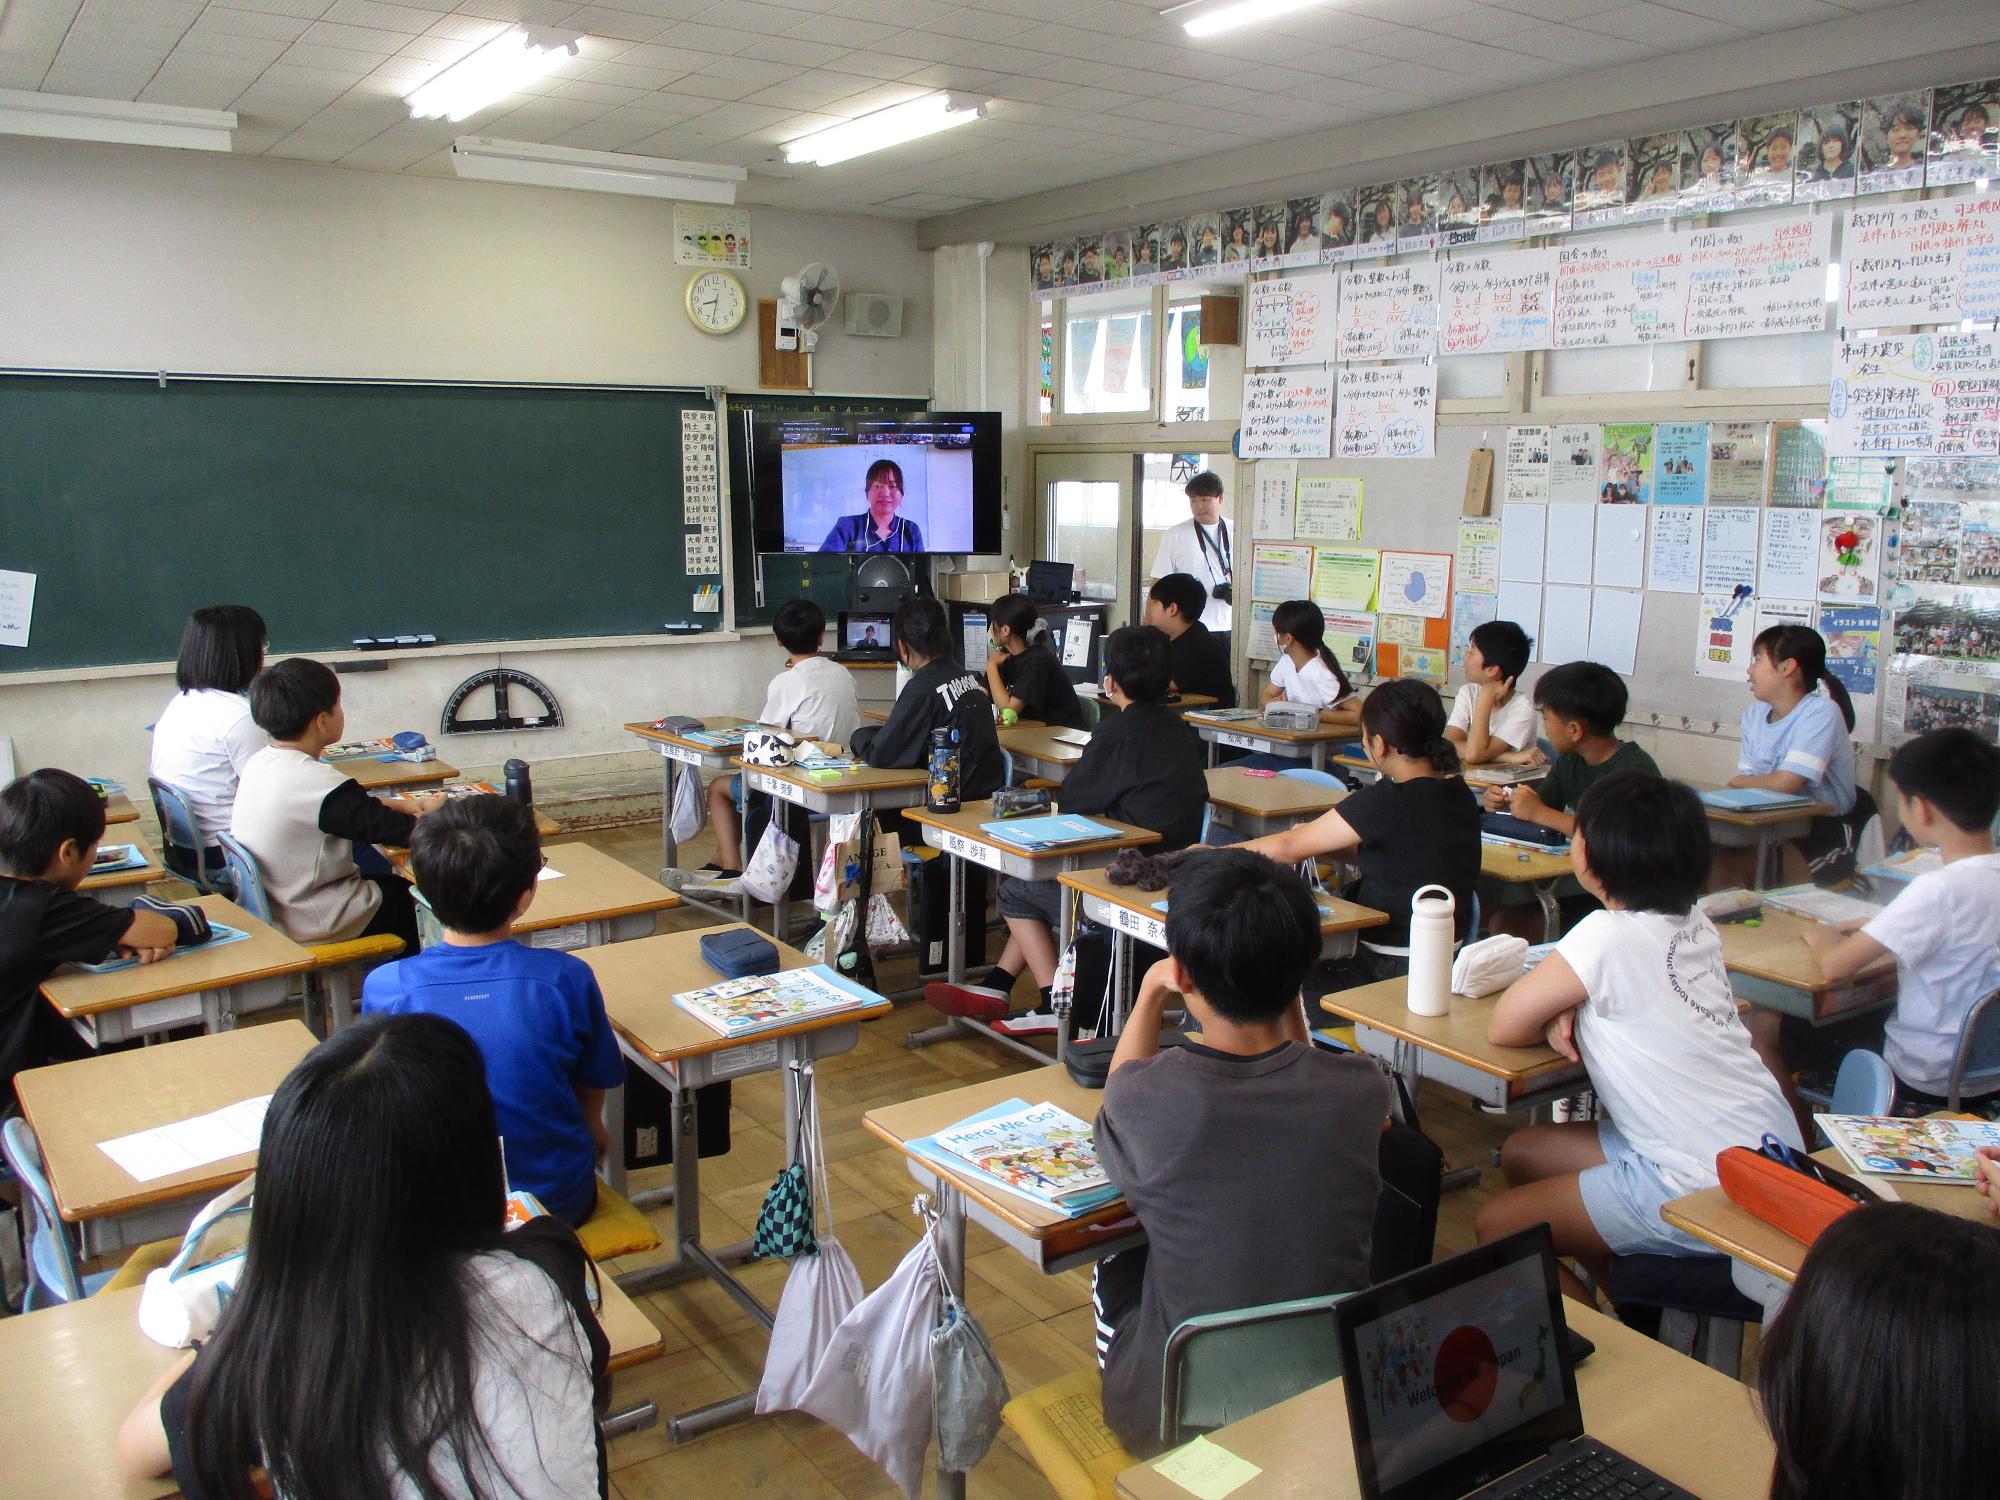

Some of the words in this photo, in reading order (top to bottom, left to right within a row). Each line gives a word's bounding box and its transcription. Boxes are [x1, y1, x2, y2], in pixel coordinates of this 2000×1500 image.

[1841, 341, 1905, 363] 東日本大震災
[1935, 383, 1950, 397] 国
[950, 835, 965, 852] 風祭
[1119, 909, 1140, 931] 鶴田
[1668, 973, 1688, 1002] today
[949, 1126, 997, 1145] Here
[999, 1116, 1027, 1134] We
[1025, 1107, 1061, 1124] Go!
